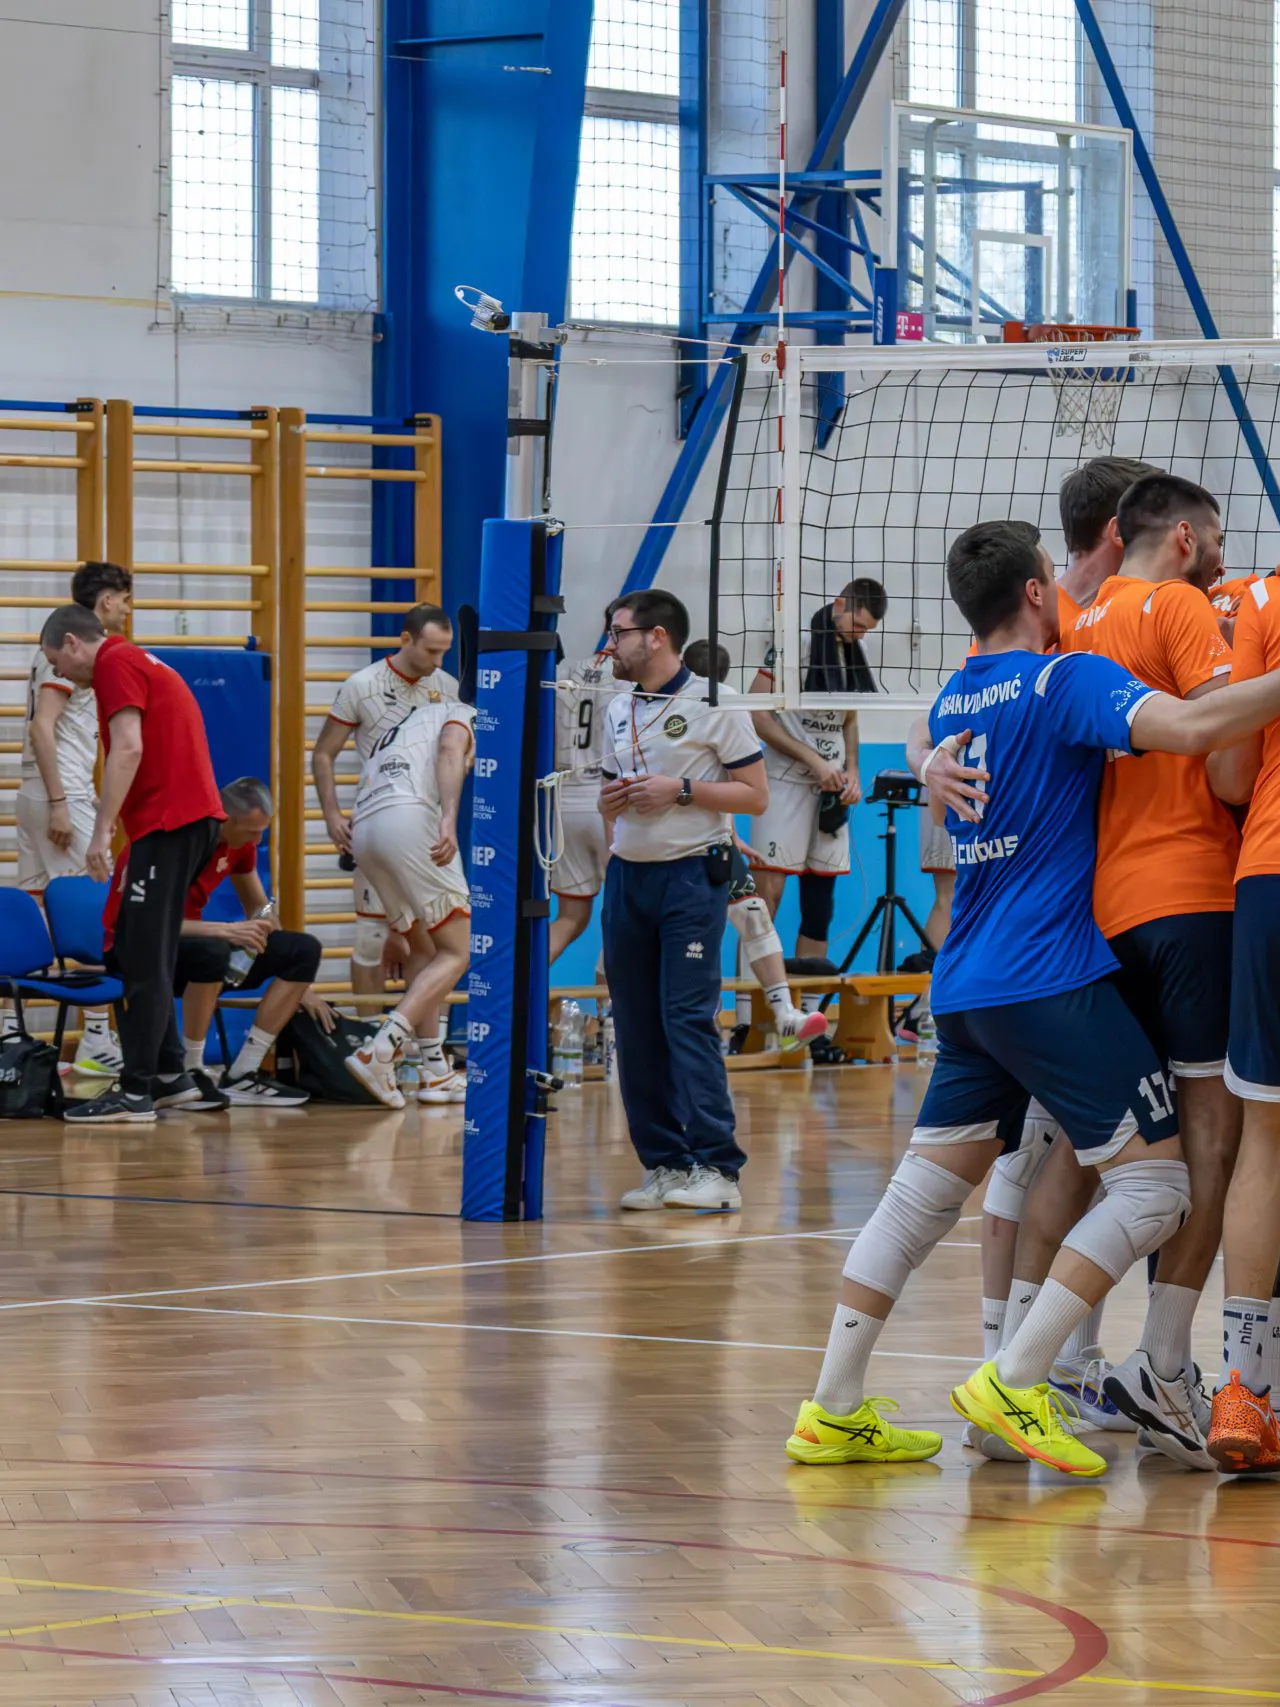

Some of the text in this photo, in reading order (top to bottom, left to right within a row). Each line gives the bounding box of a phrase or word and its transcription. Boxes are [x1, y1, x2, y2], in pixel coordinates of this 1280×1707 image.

[1060, 348, 1084, 356] SUPER
[801, 718, 843, 732] FAVBE
[768, 841, 777, 858] 3
[1138, 1070, 1174, 1123] 17
[983, 1321, 999, 1331] das
[1238, 1312, 1255, 1346] nine
